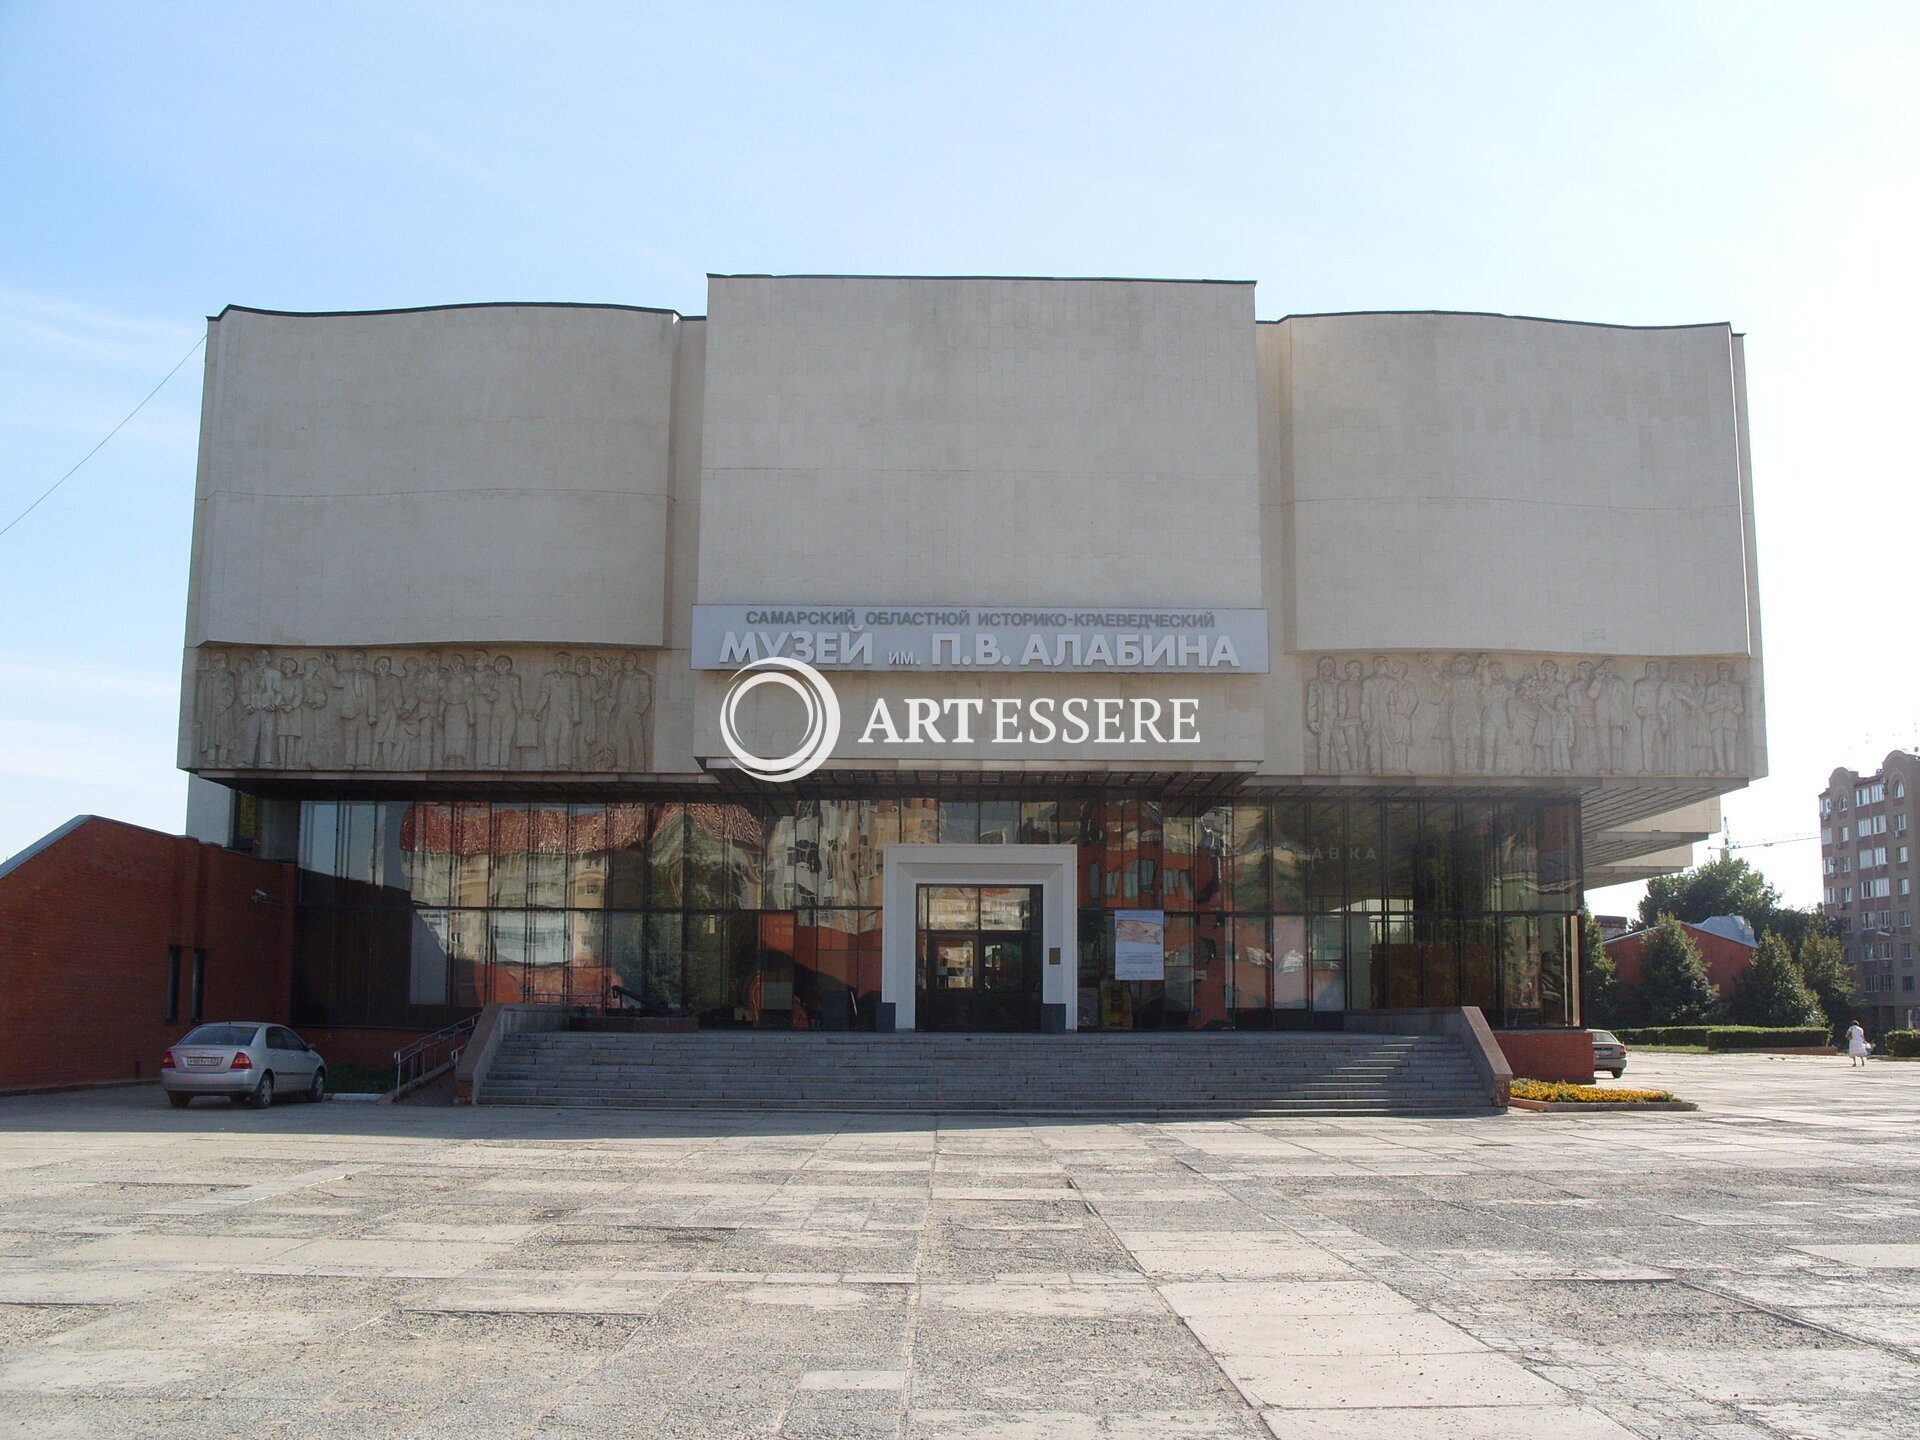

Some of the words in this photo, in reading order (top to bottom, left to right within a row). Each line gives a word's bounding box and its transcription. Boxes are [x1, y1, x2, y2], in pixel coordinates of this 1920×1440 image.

[746, 609, 855, 625] САМАРСКИЙ
[865, 609, 970, 626] ОБЛАСТНОЙ
[978, 611, 1215, 628] ИСТОРИКО-КРАЕВЕДЧЕСКИЙ
[719, 625, 874, 664] МУЗЕЙ
[1020, 633, 1240, 667] АЛАБИНА
